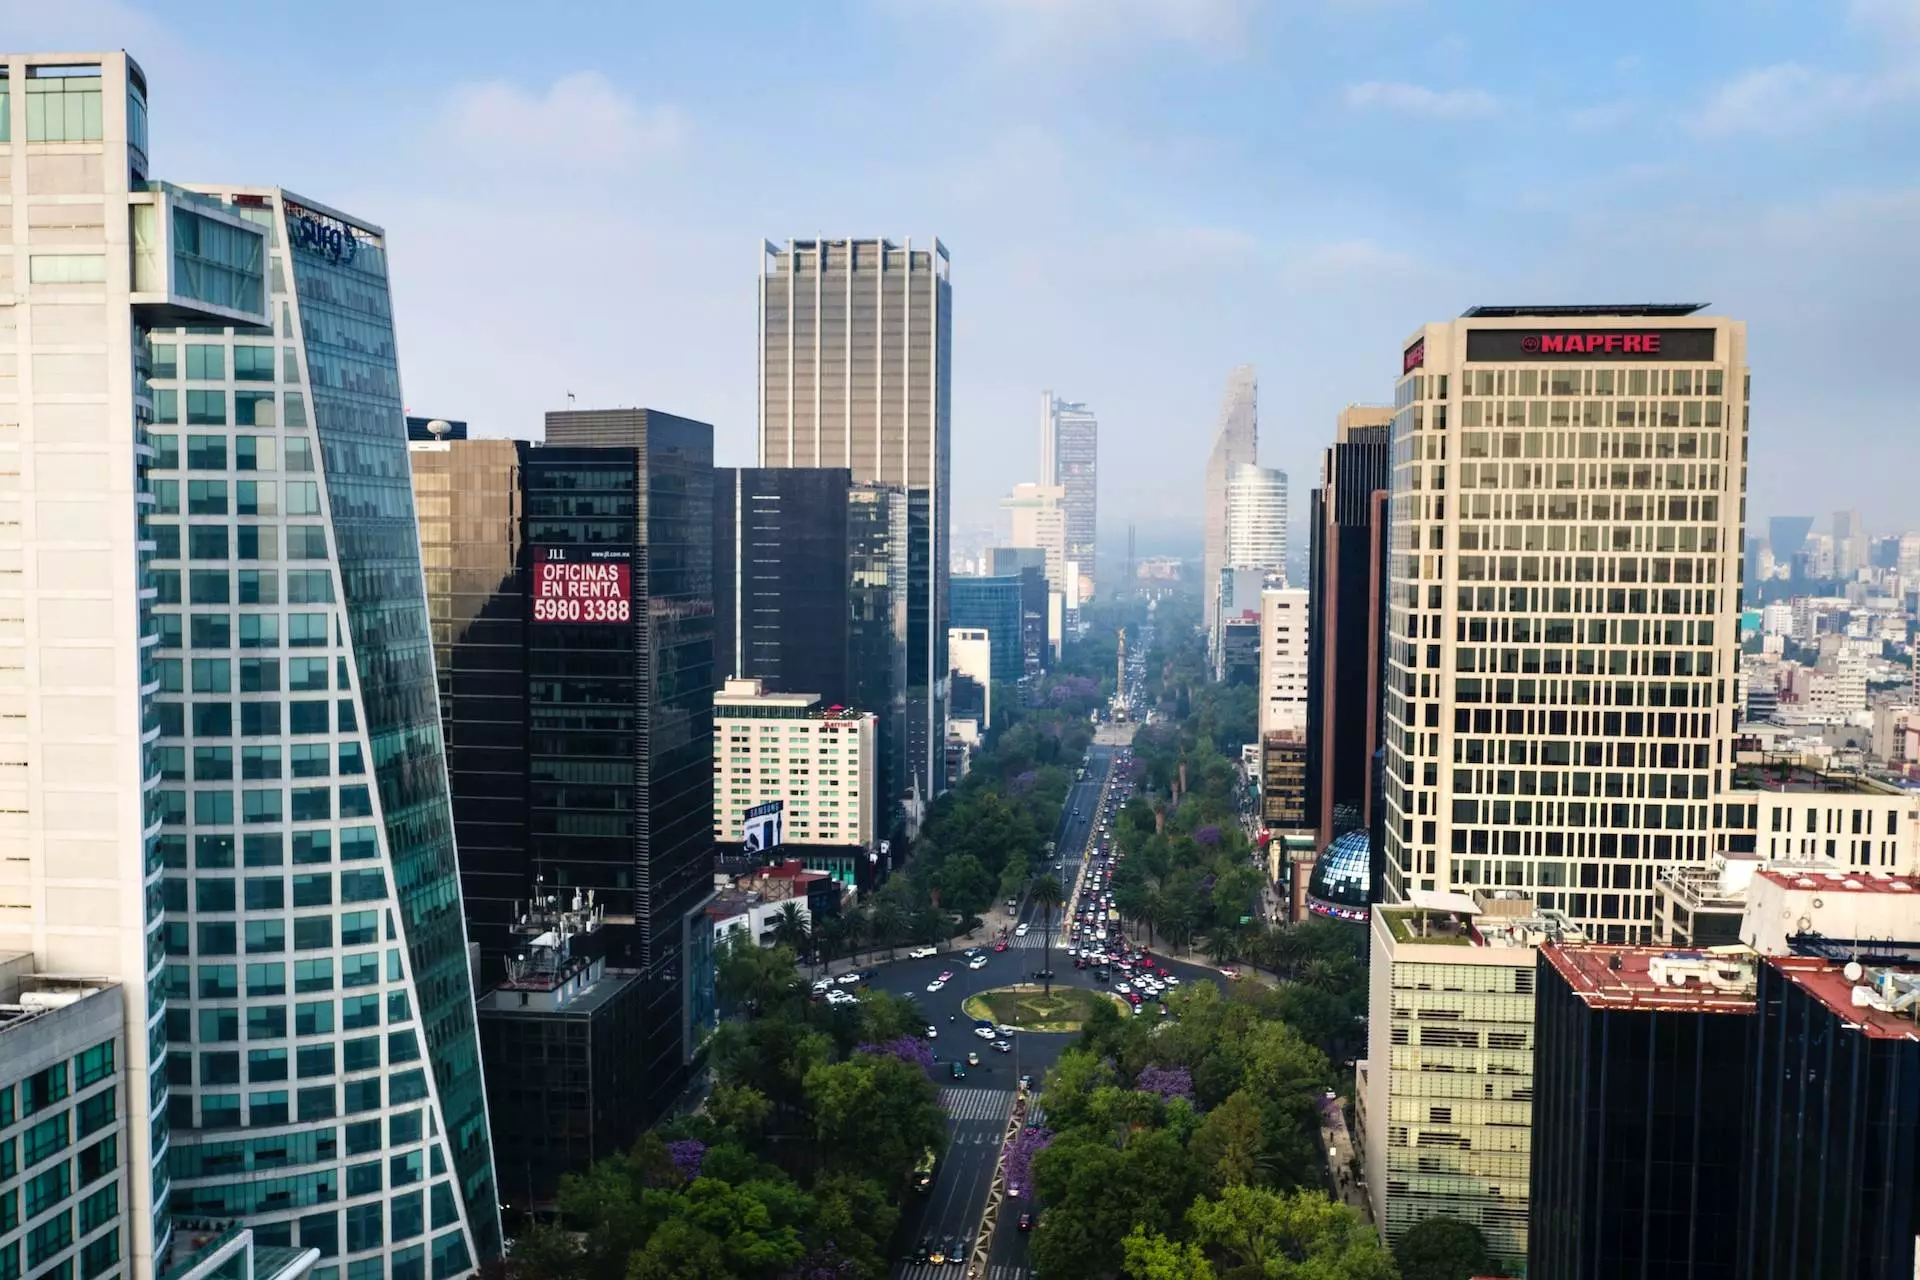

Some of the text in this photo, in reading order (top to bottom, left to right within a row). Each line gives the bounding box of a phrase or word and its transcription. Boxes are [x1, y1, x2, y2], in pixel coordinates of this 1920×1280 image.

[1541, 334, 1661, 353] MAPFRE
[547, 549, 566, 559] JLL
[543, 564, 619, 581] OFICINAS
[541, 581, 621, 597] EN RENTA
[534, 599, 630, 621] 5980 3388
